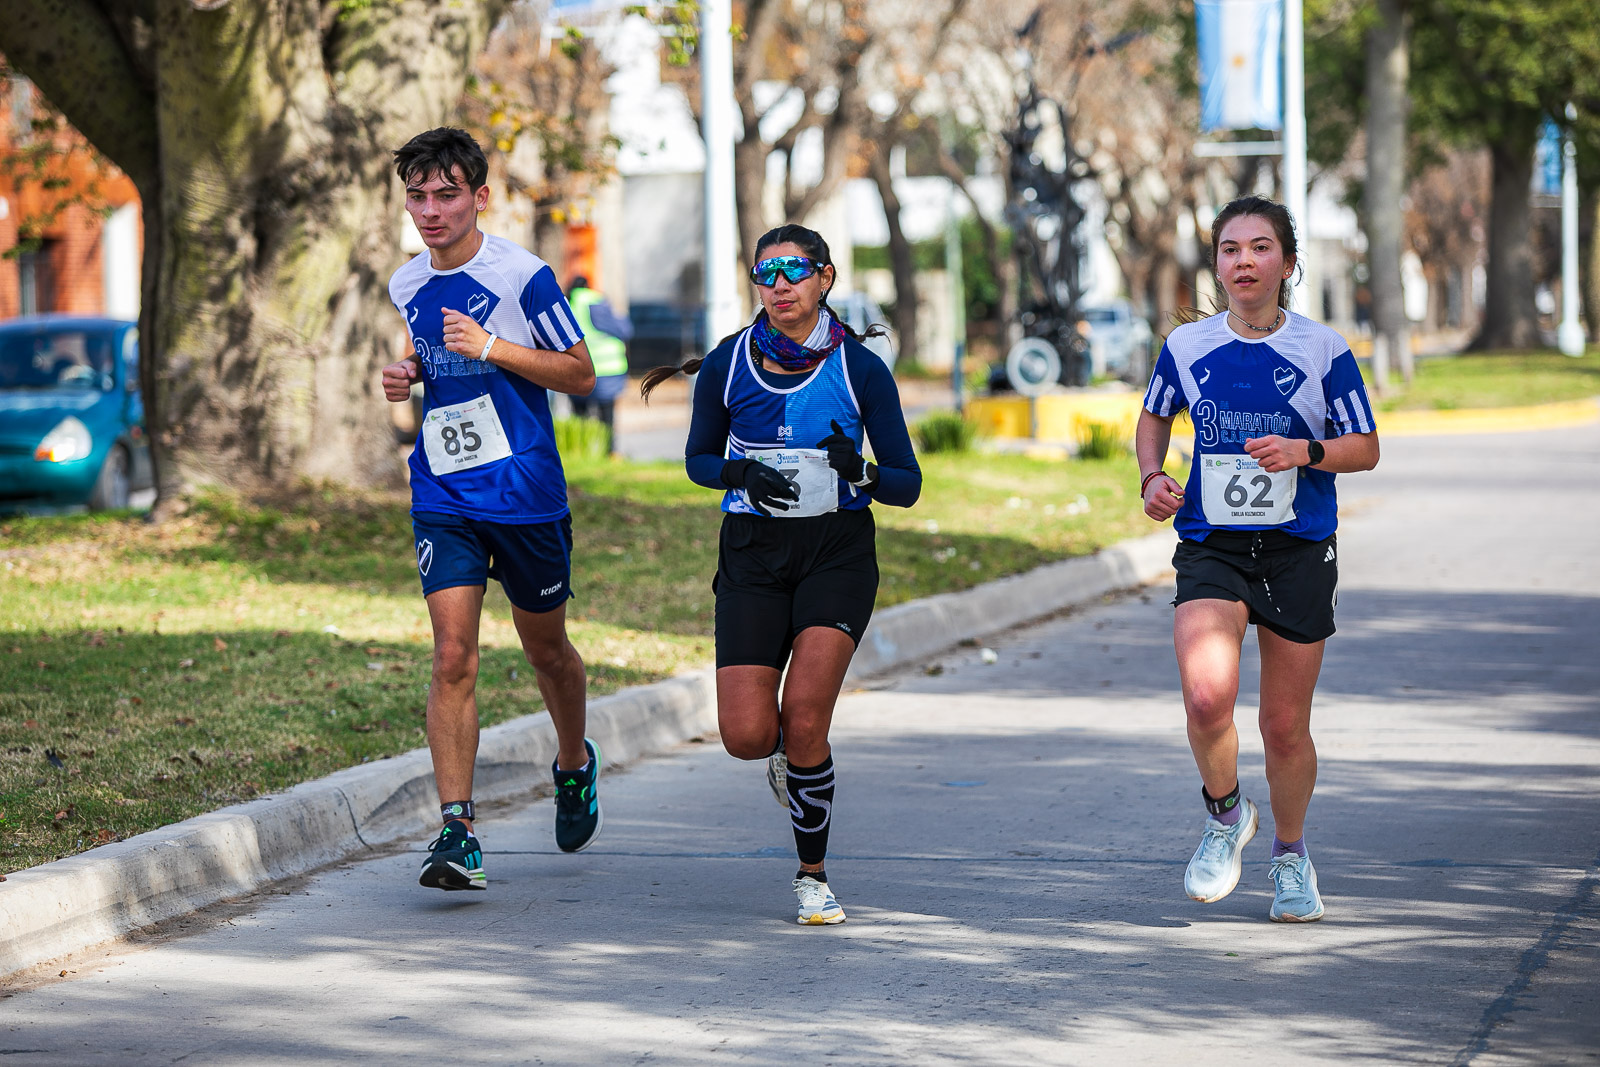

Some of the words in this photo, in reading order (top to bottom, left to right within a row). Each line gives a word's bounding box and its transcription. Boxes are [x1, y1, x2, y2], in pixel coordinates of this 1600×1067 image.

[441, 421, 482, 456] 85
[1197, 400, 1219, 447] 3
[1220, 411, 1291, 434] MARATÓN
[1224, 475, 1274, 507] 62
[541, 581, 562, 596] KION
